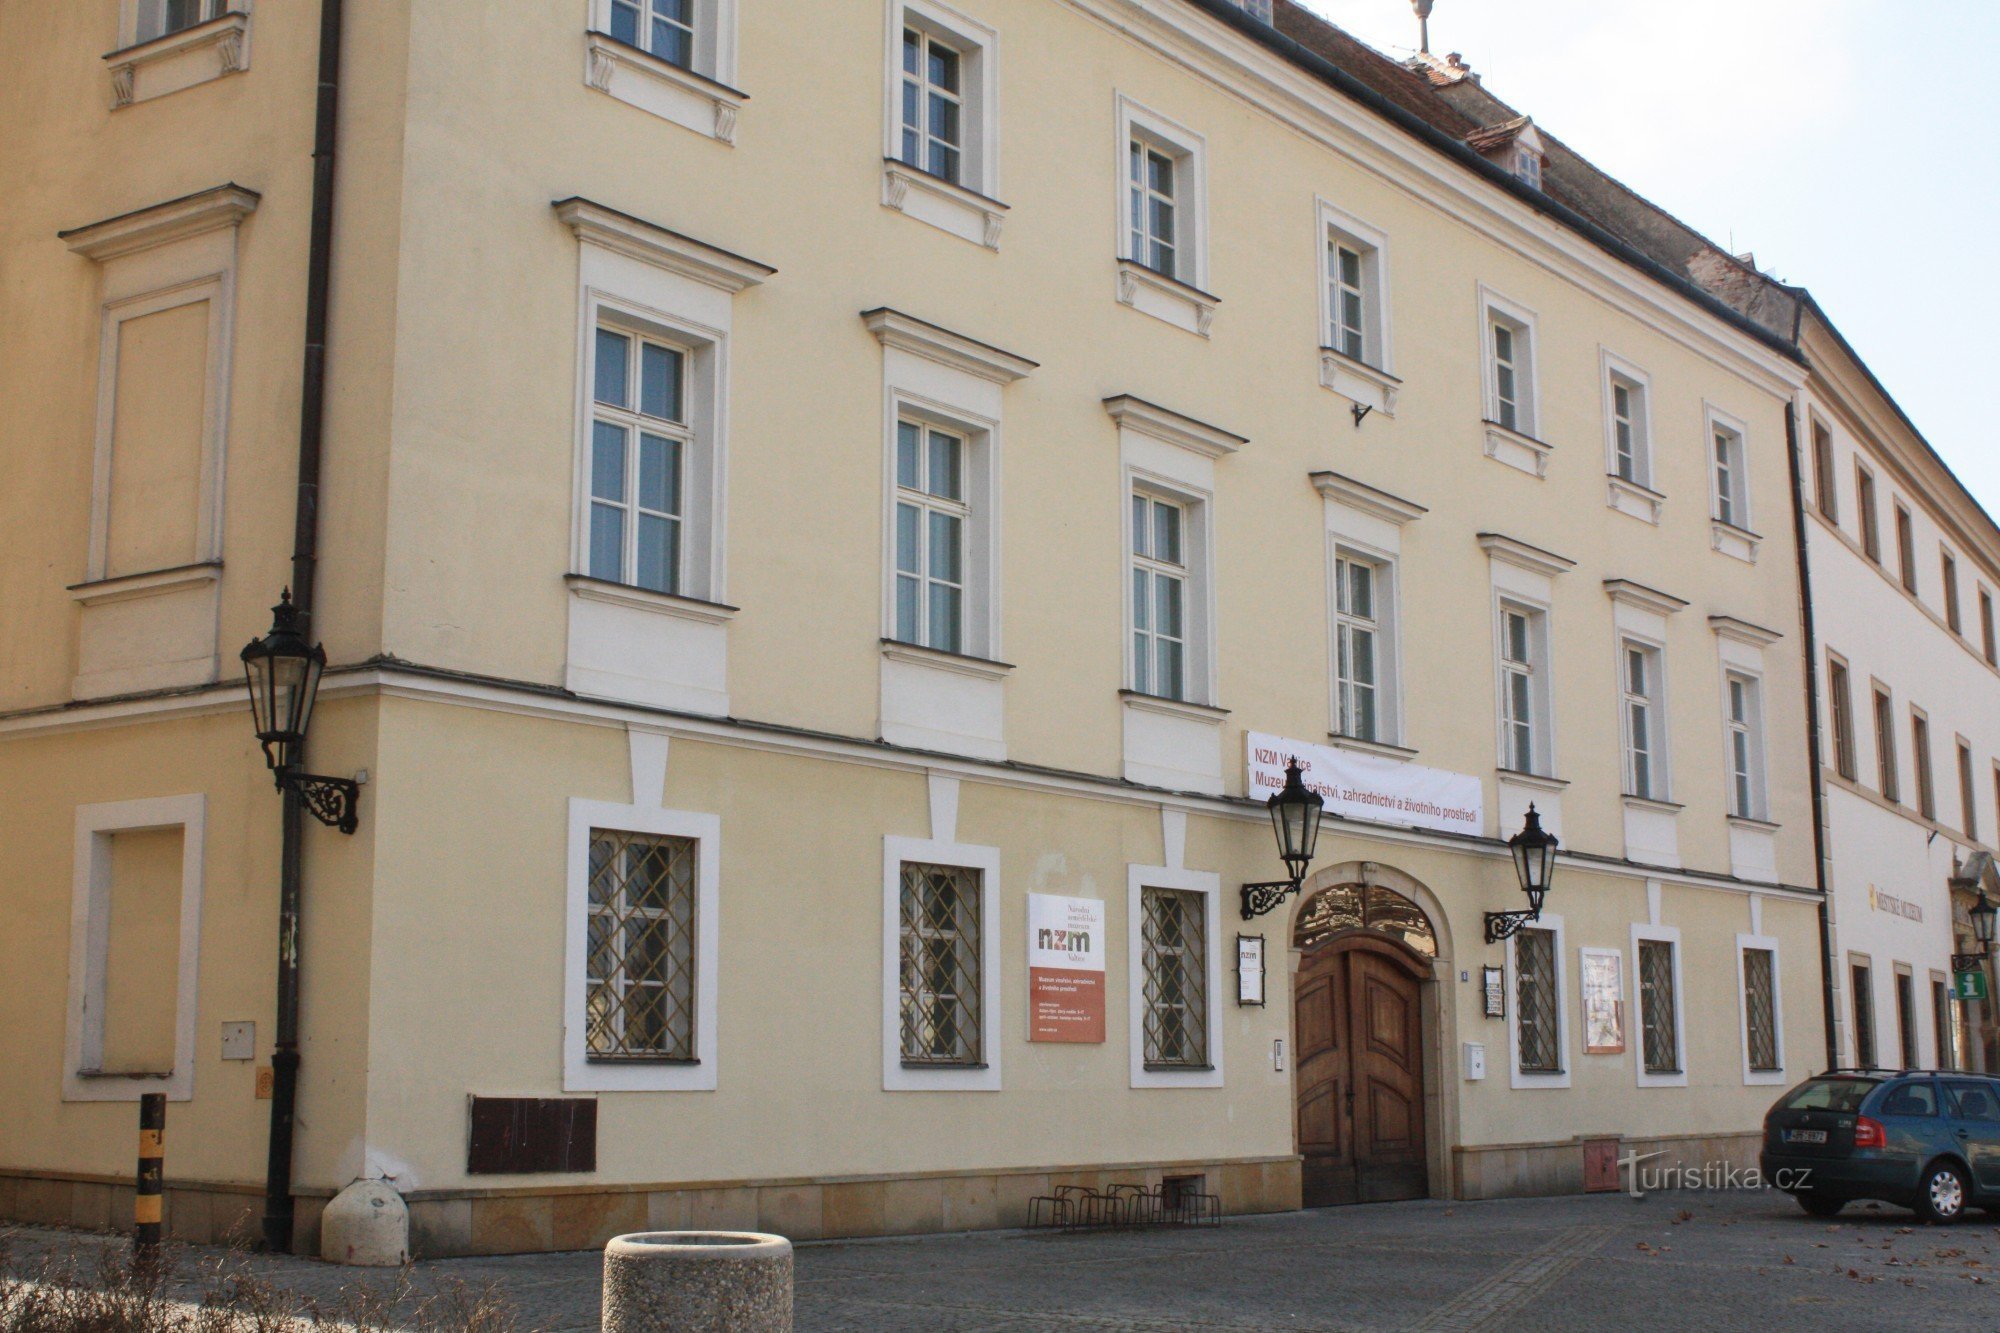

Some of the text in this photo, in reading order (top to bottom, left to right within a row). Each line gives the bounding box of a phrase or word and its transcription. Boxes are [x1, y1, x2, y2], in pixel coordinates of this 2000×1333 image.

[1255, 748, 1278, 766] NZM
[1397, 800, 1402, 809] a
[1038, 928, 1090, 953] nzm
